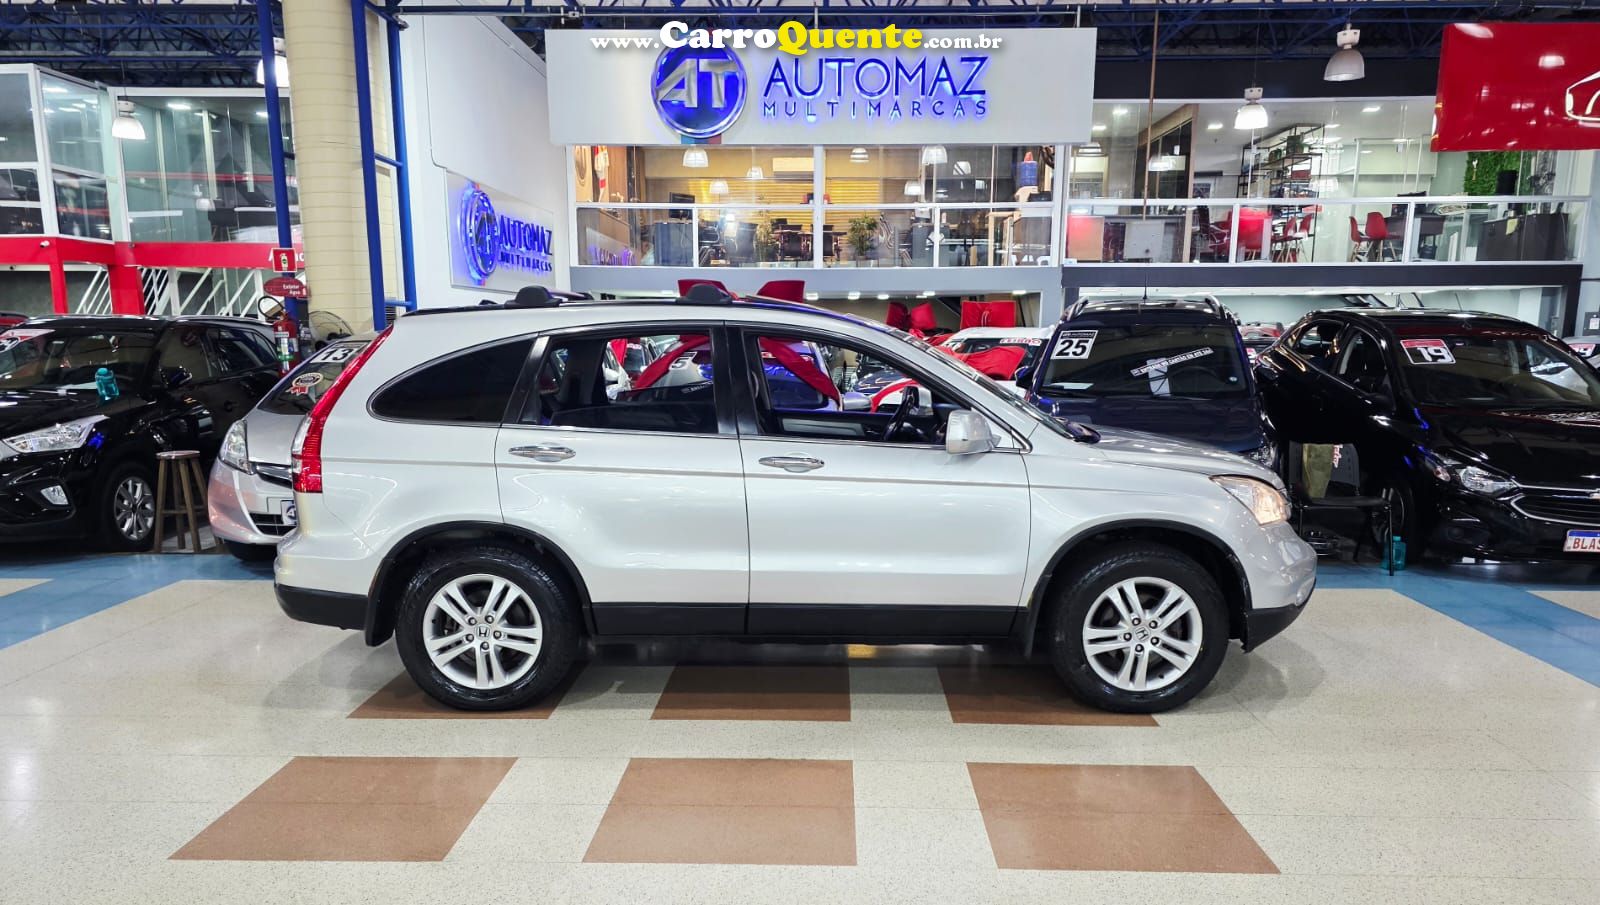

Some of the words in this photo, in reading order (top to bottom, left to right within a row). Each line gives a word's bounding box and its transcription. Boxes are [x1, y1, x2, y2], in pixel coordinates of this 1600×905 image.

[763, 56, 988, 98] AUTOMAZ
[763, 101, 986, 117] MULTIMARCAS
[499, 215, 553, 256] AUTOMAZ
[321, 347, 354, 361] 13
[1055, 339, 1090, 357] 25
[1417, 346, 1453, 362] 19
